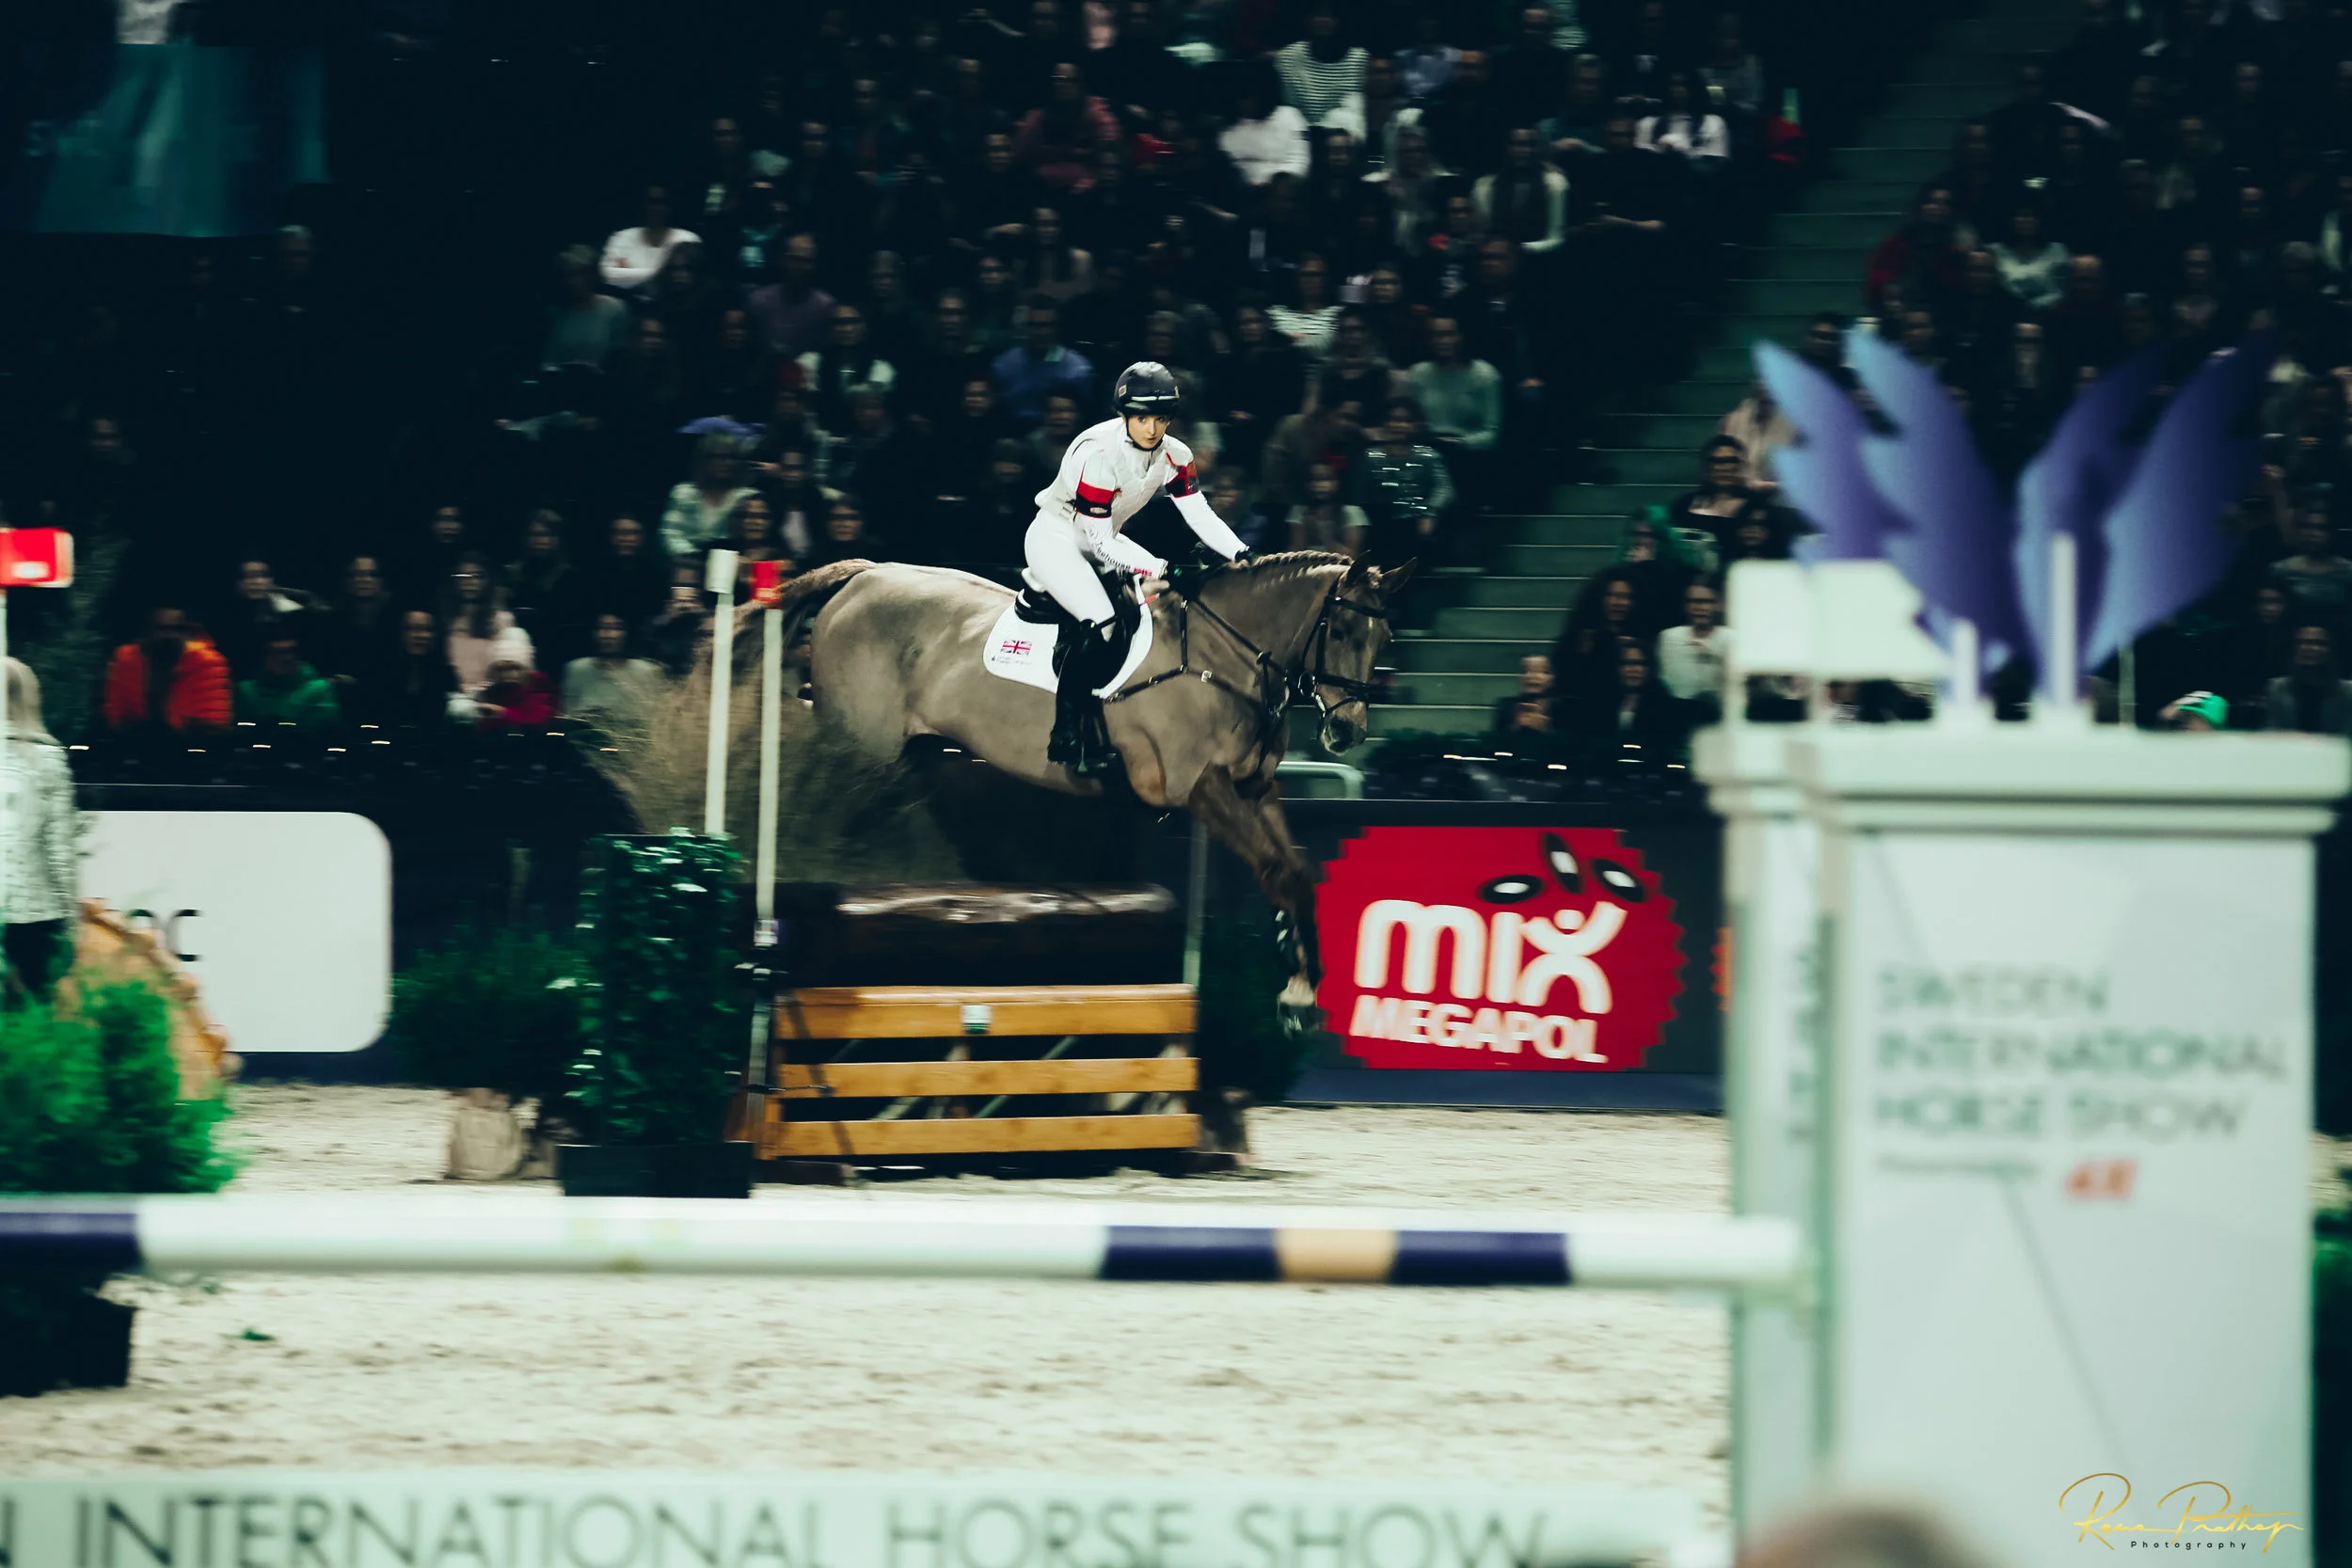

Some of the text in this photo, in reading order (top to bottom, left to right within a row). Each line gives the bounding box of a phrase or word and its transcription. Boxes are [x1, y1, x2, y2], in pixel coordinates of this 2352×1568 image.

[1349, 994, 1610, 1064] MEGAPOL
[1877, 1028, 2288, 1084] INTERNATIONAL
[75, 1496, 833, 1568] INTERNATIONAL
[882, 1499, 1194, 1568] HORSE
[1234, 1503, 1550, 1568] SHOW
